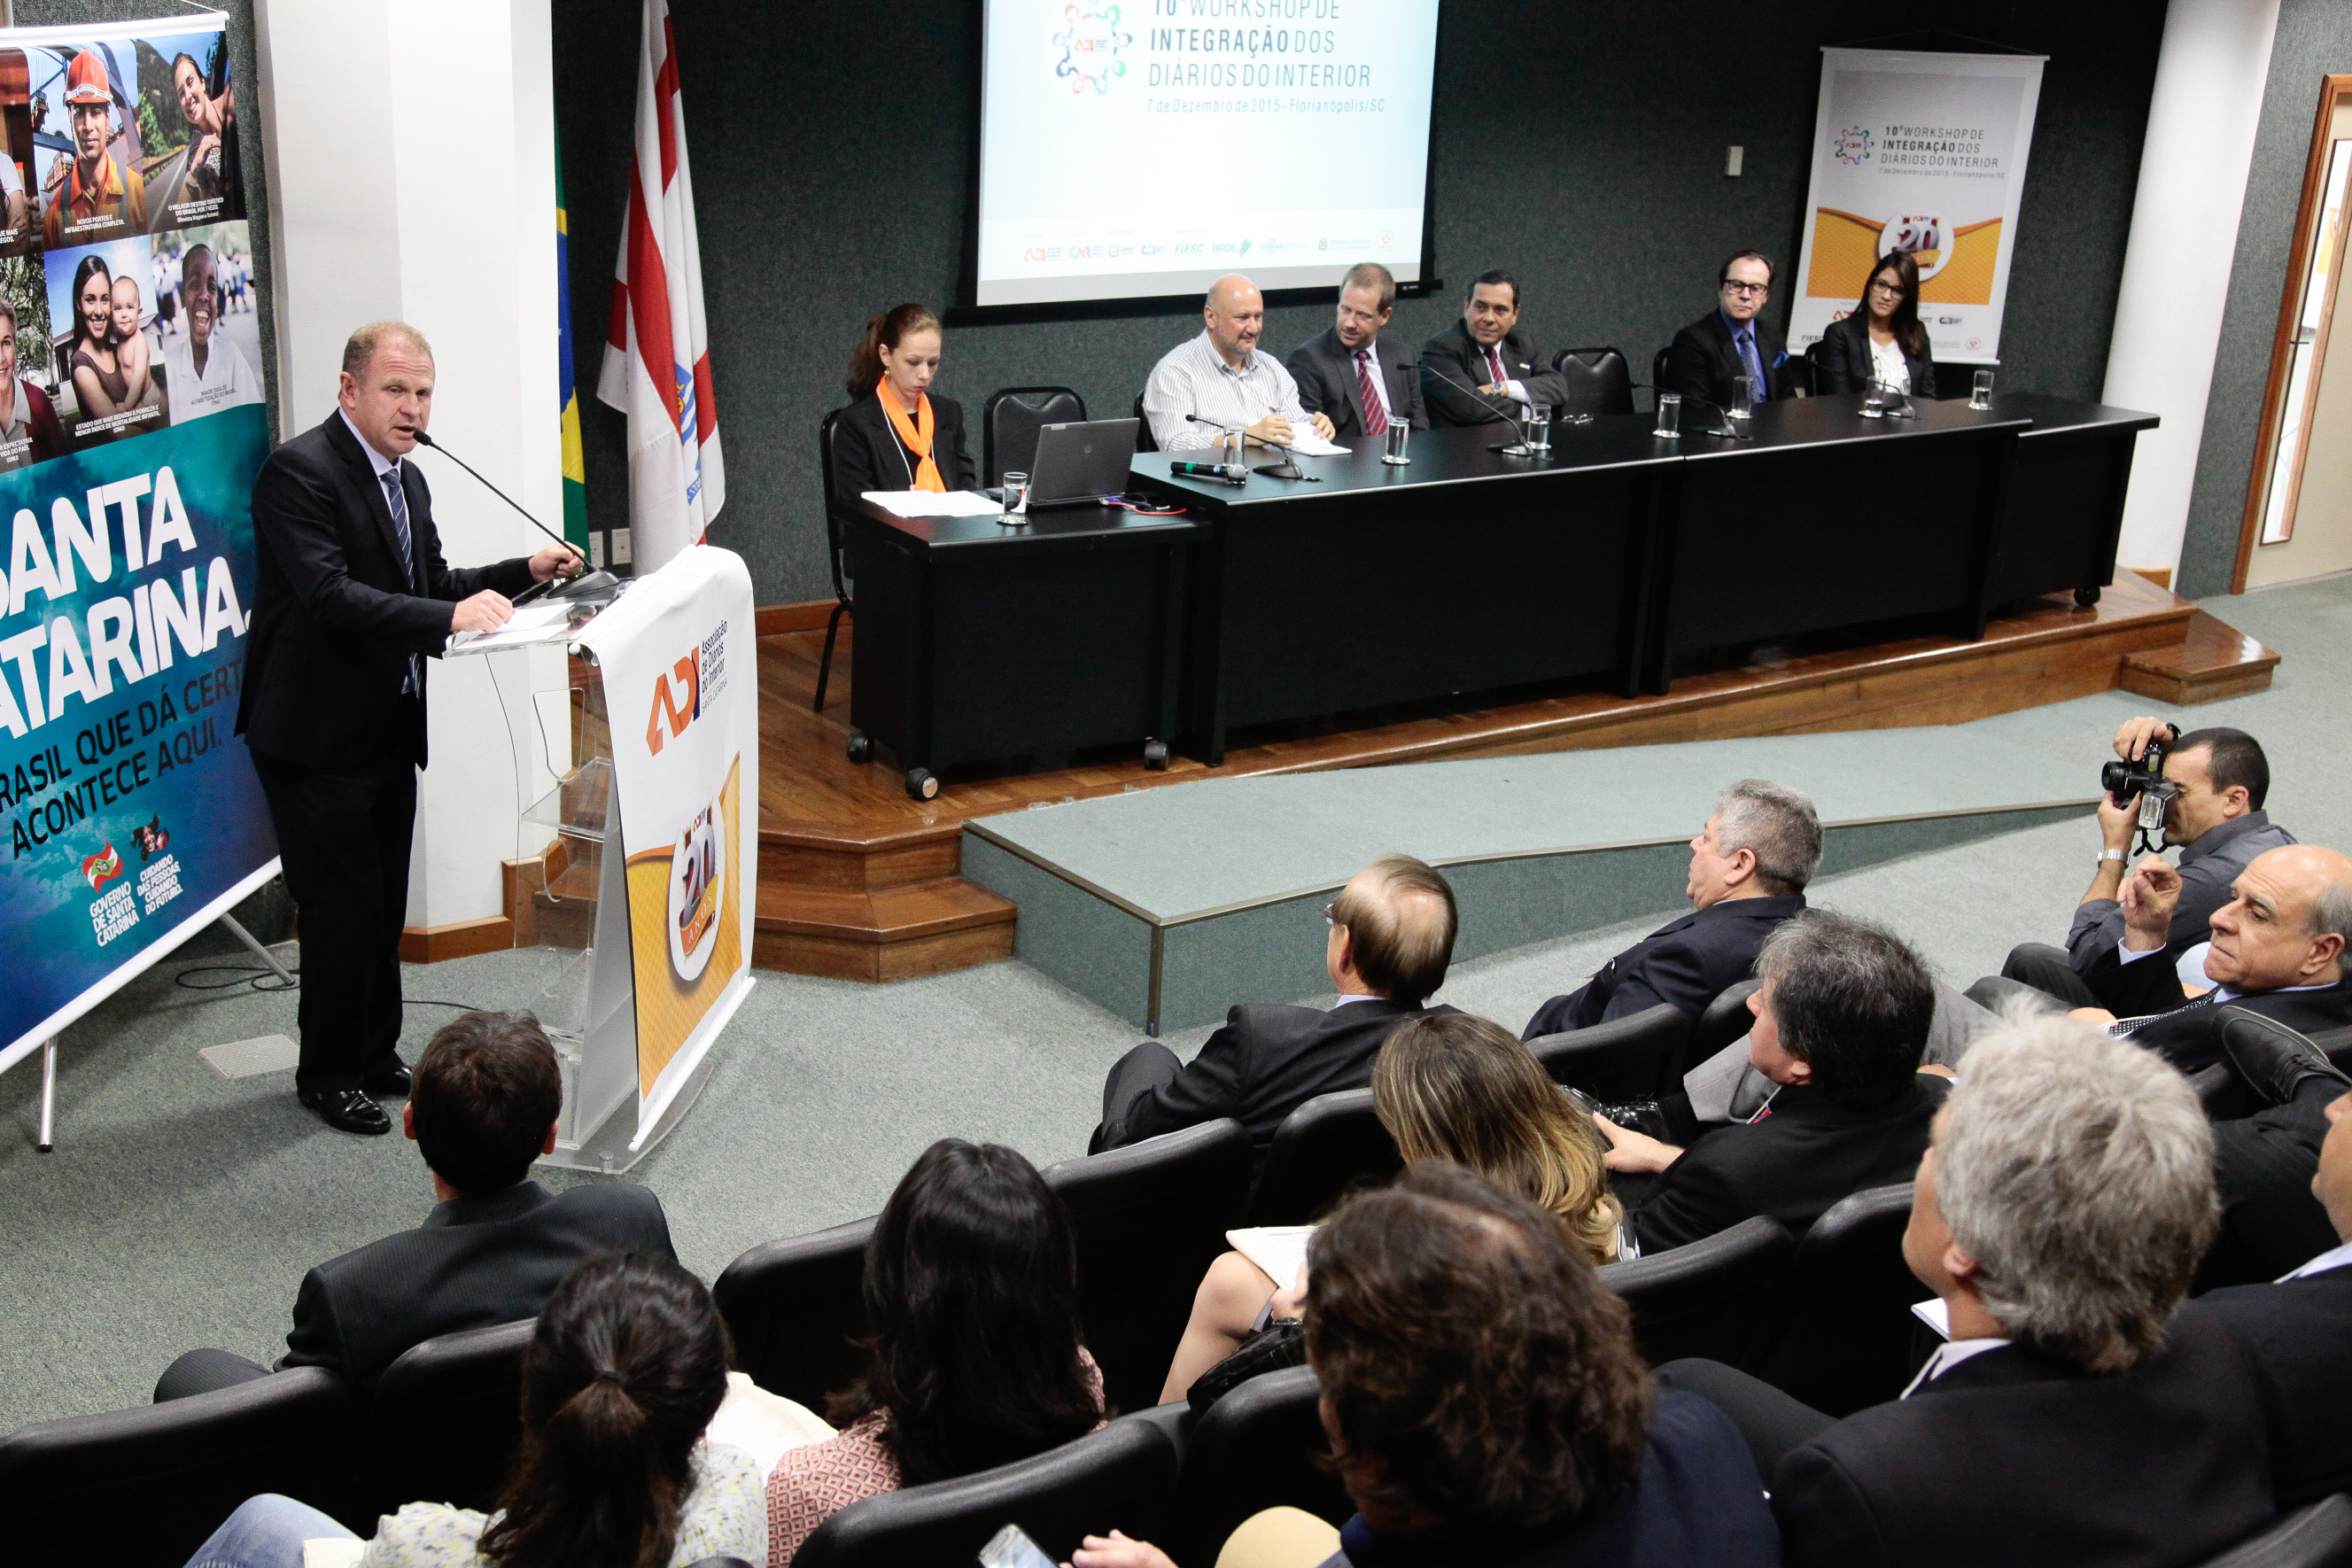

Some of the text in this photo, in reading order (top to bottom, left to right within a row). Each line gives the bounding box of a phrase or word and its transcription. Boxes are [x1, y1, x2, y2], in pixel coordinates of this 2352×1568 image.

[1155, 0, 1340, 19] 10 WORKSHOP DE
[1150, 25, 1335, 58] INTEGRAÇÃO DOS
[1148, 58, 1371, 88] DIÁRIOS DO INTERIOR
[1146, 98, 1154, 113] 7
[1156, 98, 1170, 113] de
[1172, 98, 1232, 113] Dezembro
[1235, 98, 1249, 113] de
[1250, 98, 1281, 113] 2015
[1289, 97, 1386, 115] Florianópolis/SC
[1882, 139, 1981, 154] INTEGRAÇÃO DOS
[1904, 127, 1968, 139] WORKSHOP
[1970, 128, 1984, 140] DE
[1880, 151, 1999, 168] DIÁRIOS DO INTERIOR
[76, 217, 92, 226] NOVOS
[93, 214, 109, 223] PORTOS
[172, 202, 190, 211] MELHOR
[182, 207, 198, 216] BRASIL
[0, 236, 15, 245] EGOS.
[5, 228, 19, 237] MAIS
[64, 219, 126, 234] INFRAESTRUTURA COMPLETA.
[1897, 221, 1940, 253] 20
[1175, 244, 1205, 253] FIESC
[1212, 243, 1238, 253] BRDE
[74, 428, 92, 438] MENOR
[111, 415, 142, 428] MORTALIDADE
[141, 410, 161, 420] INFANTIL.
[75, 420, 94, 431] ESTADO
[103, 415, 114, 424] MAIS
[113, 411, 132, 421] REDUZIU
[136, 405, 156, 415] POBREZA
[113, 425, 126, 434] (ONU)
[0, 449, 12, 458] VIDA
[18, 444, 30, 453] PAÍS.
[4, 437, 34, 450] EXPECTATIVA
[6, 454, 19, 463] (ONU)
[0, 465, 198, 621] ANTA
[701, 619, 727, 658] Associação
[702, 641, 724, 676] de Diários
[702, 657, 725, 694] do Interior
[702, 677, 728, 713] SANTA CATARINA
[0, 658, 245, 813] RASIL QUE DÁ CERT
[12, 717, 222, 860] ACONTECE AQUI.
[139, 853, 175, 882] CUIDANDO
[681, 822, 716, 928] 20
[89, 881, 132, 918] GOVERNO
[136, 880, 151, 897] DAS
[144, 873, 179, 904] CUIDANDO
[144, 883, 184, 916] DO FUTURO.
[92, 895, 136, 934] DE SANTA
[97, 909, 141, 948] CATARINA
[688, 894, 713, 944] ANOS
